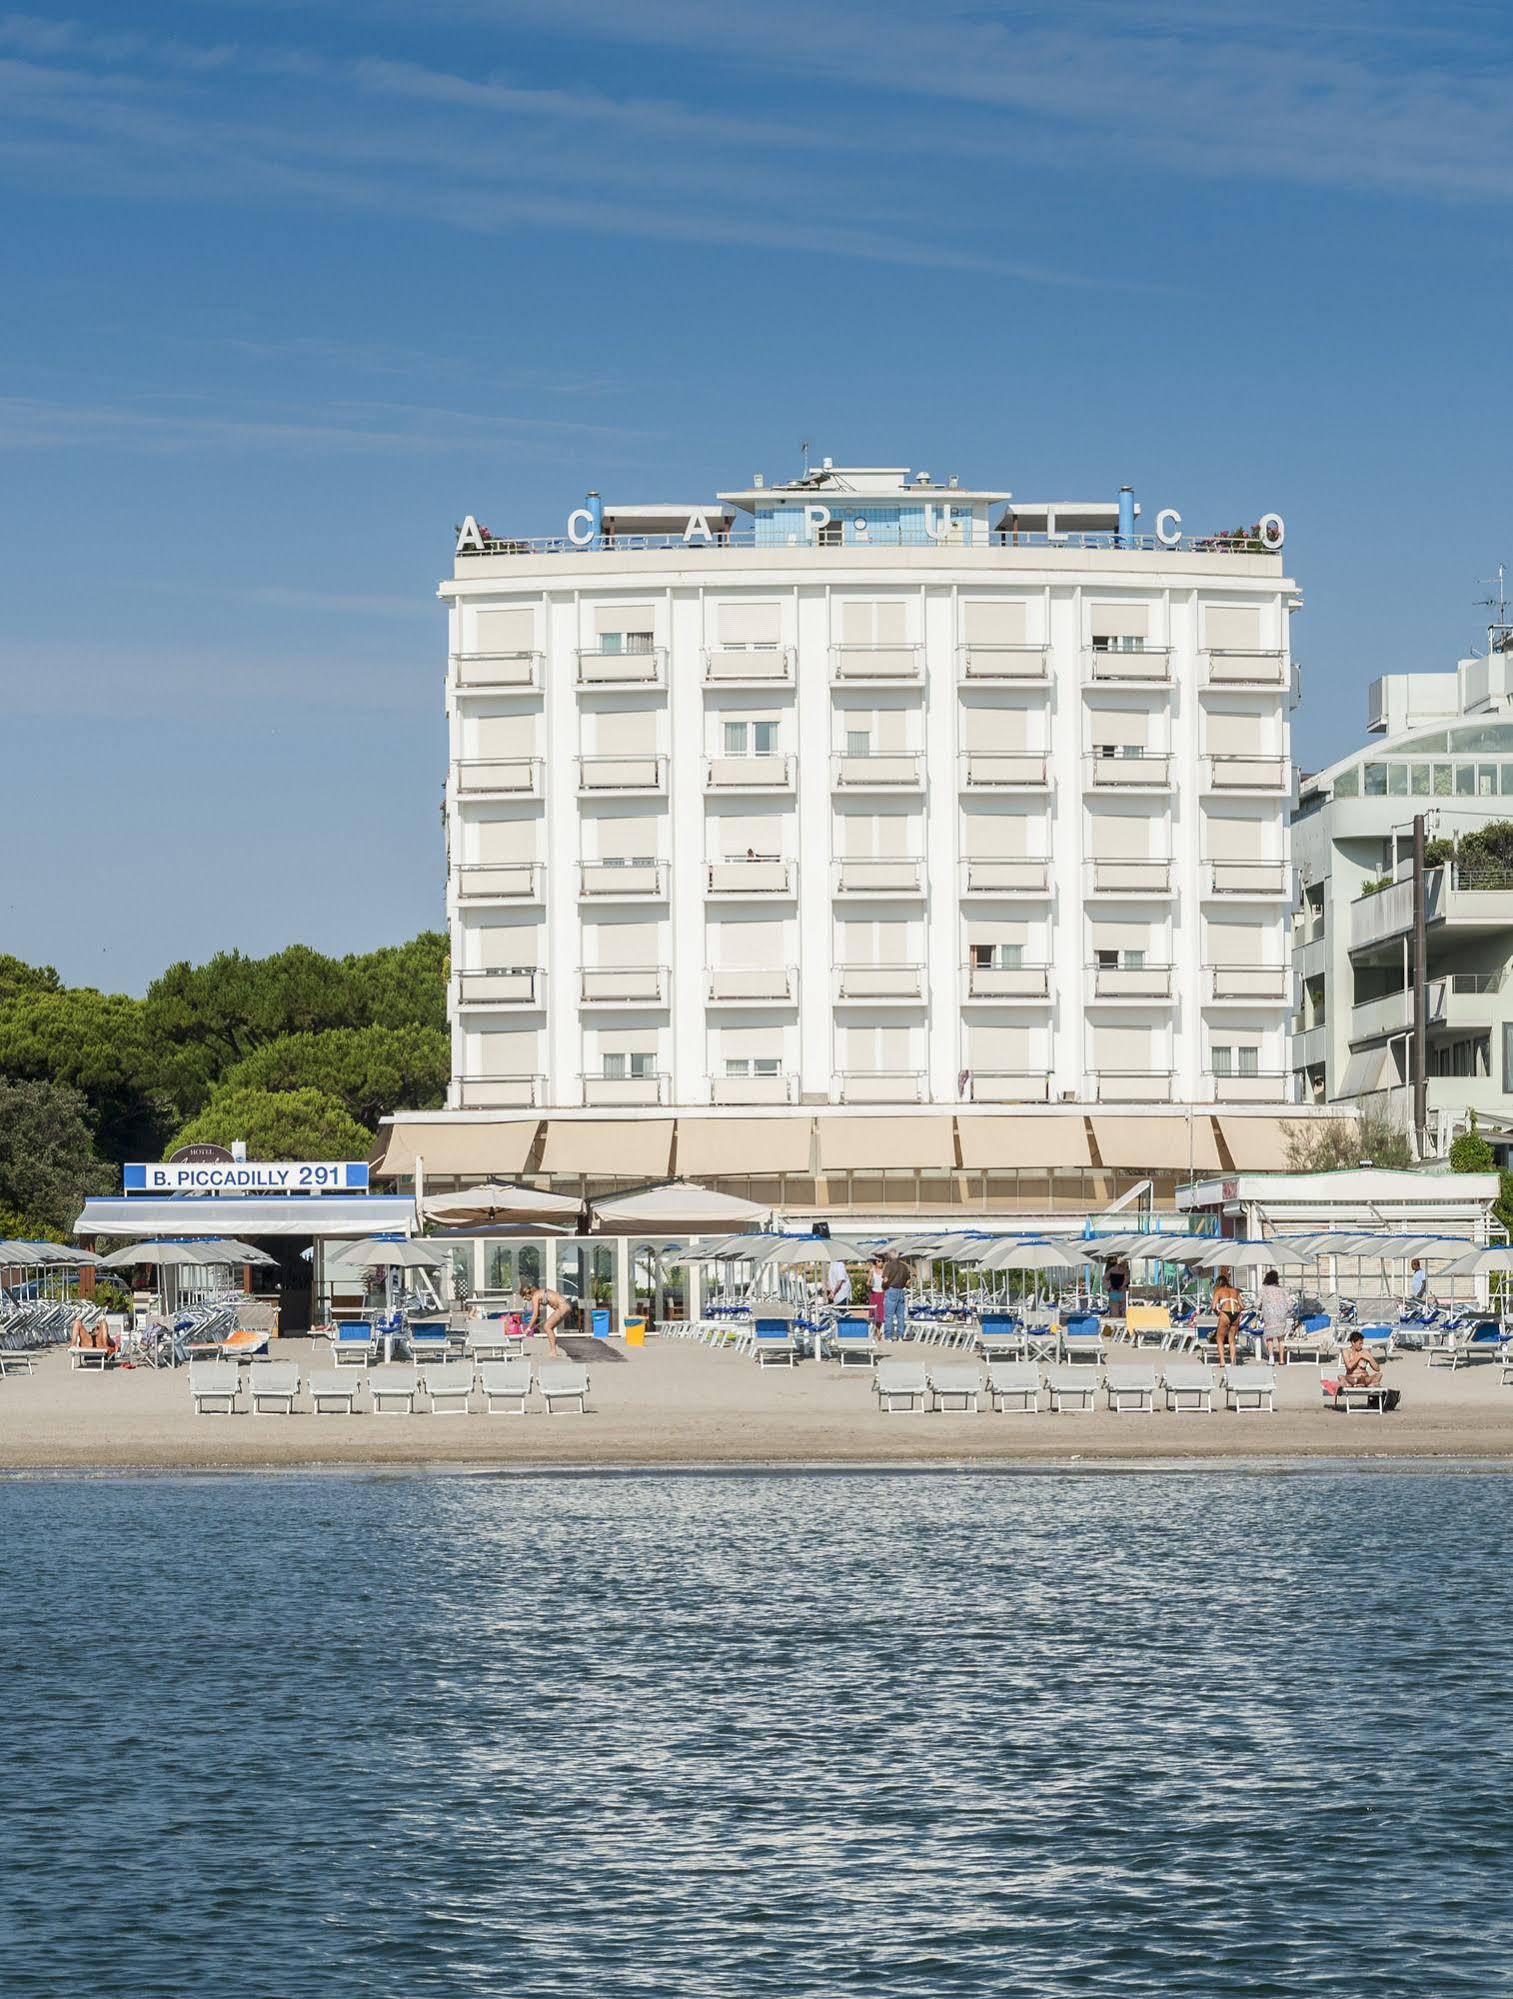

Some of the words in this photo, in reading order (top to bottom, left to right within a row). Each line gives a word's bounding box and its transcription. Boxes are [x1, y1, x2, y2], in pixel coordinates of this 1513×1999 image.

[456, 503, 1285, 550] ACAPULCO
[154, 1171, 171, 1186] B.
[178, 1170, 289, 1186] PICCADILLY
[299, 1166, 338, 1185] 291
